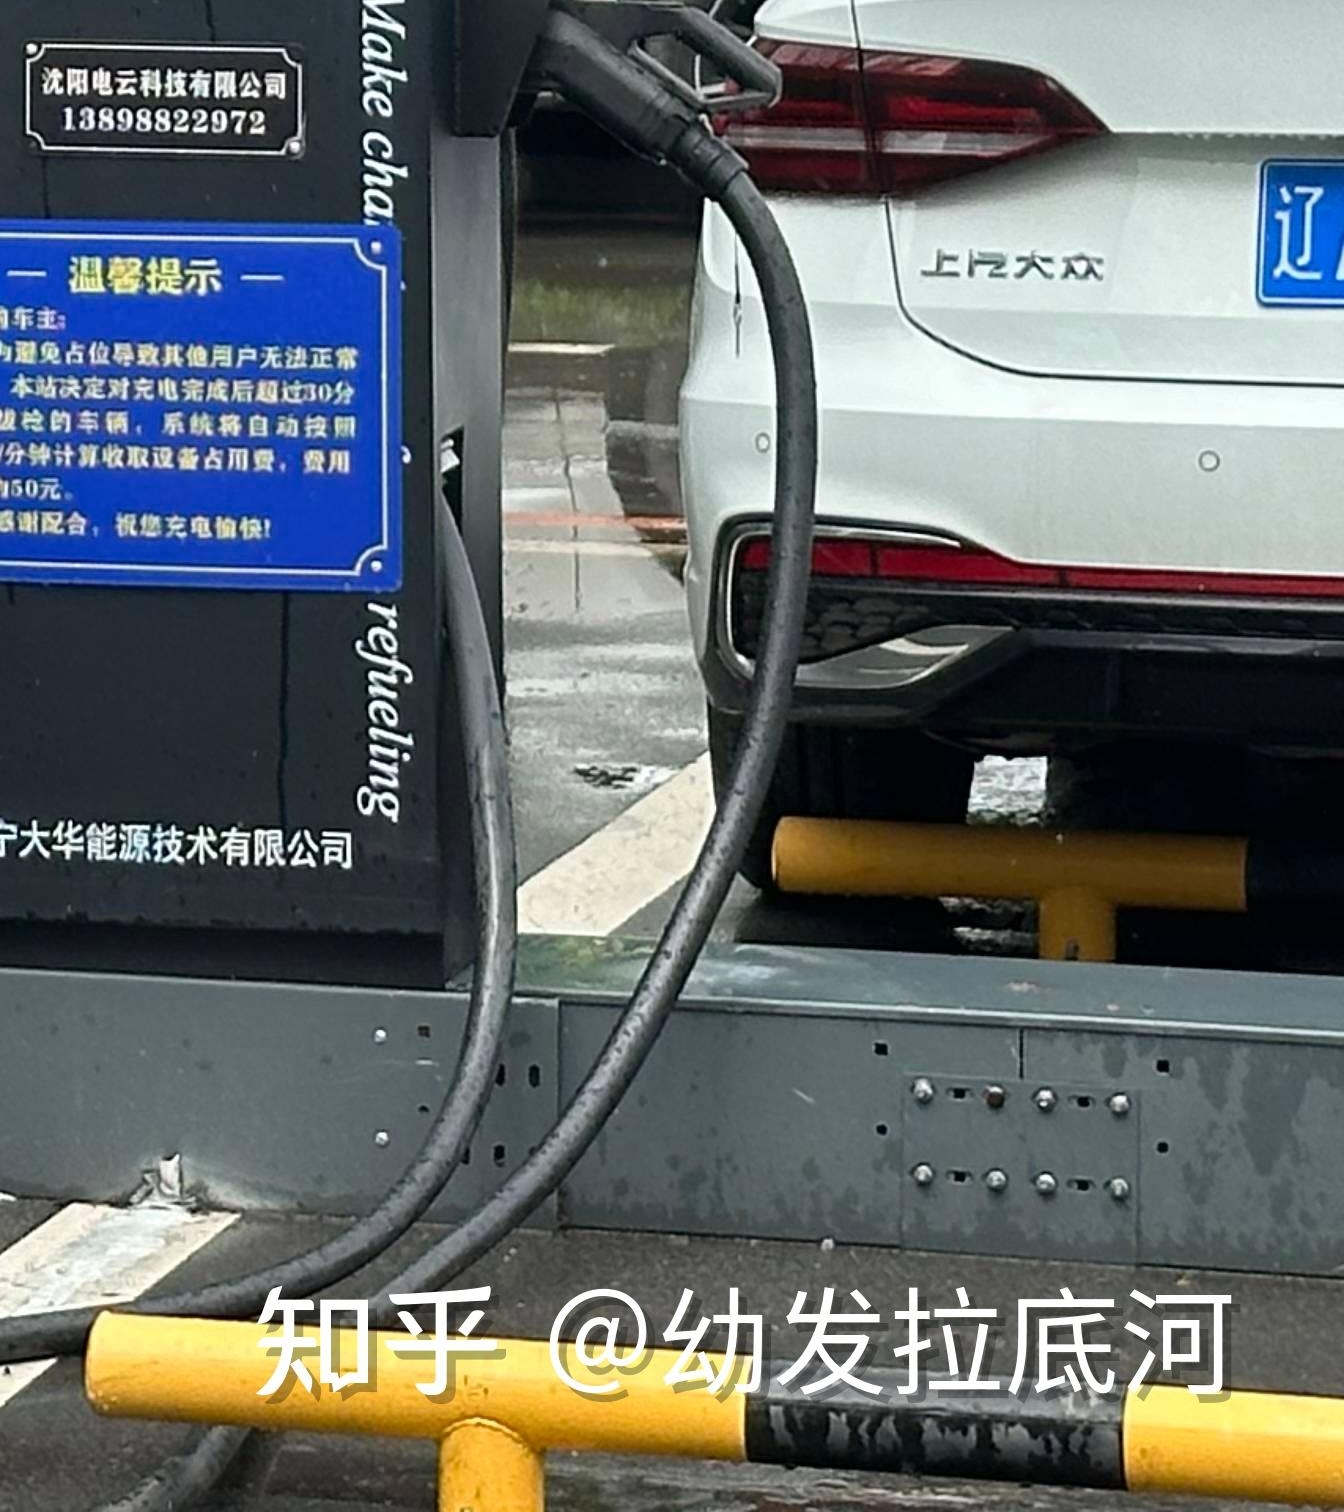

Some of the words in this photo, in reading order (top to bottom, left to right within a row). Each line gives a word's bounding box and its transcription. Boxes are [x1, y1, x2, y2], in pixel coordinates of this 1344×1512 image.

[41, 66, 287, 100] 沈阳电云科技有限公司
[63, 106, 267, 135] 13898822972
[68, 256, 222, 296] 温馨提示
[920, 248, 1103, 281] 上汽大众
[355, 602, 414, 823] refueling
